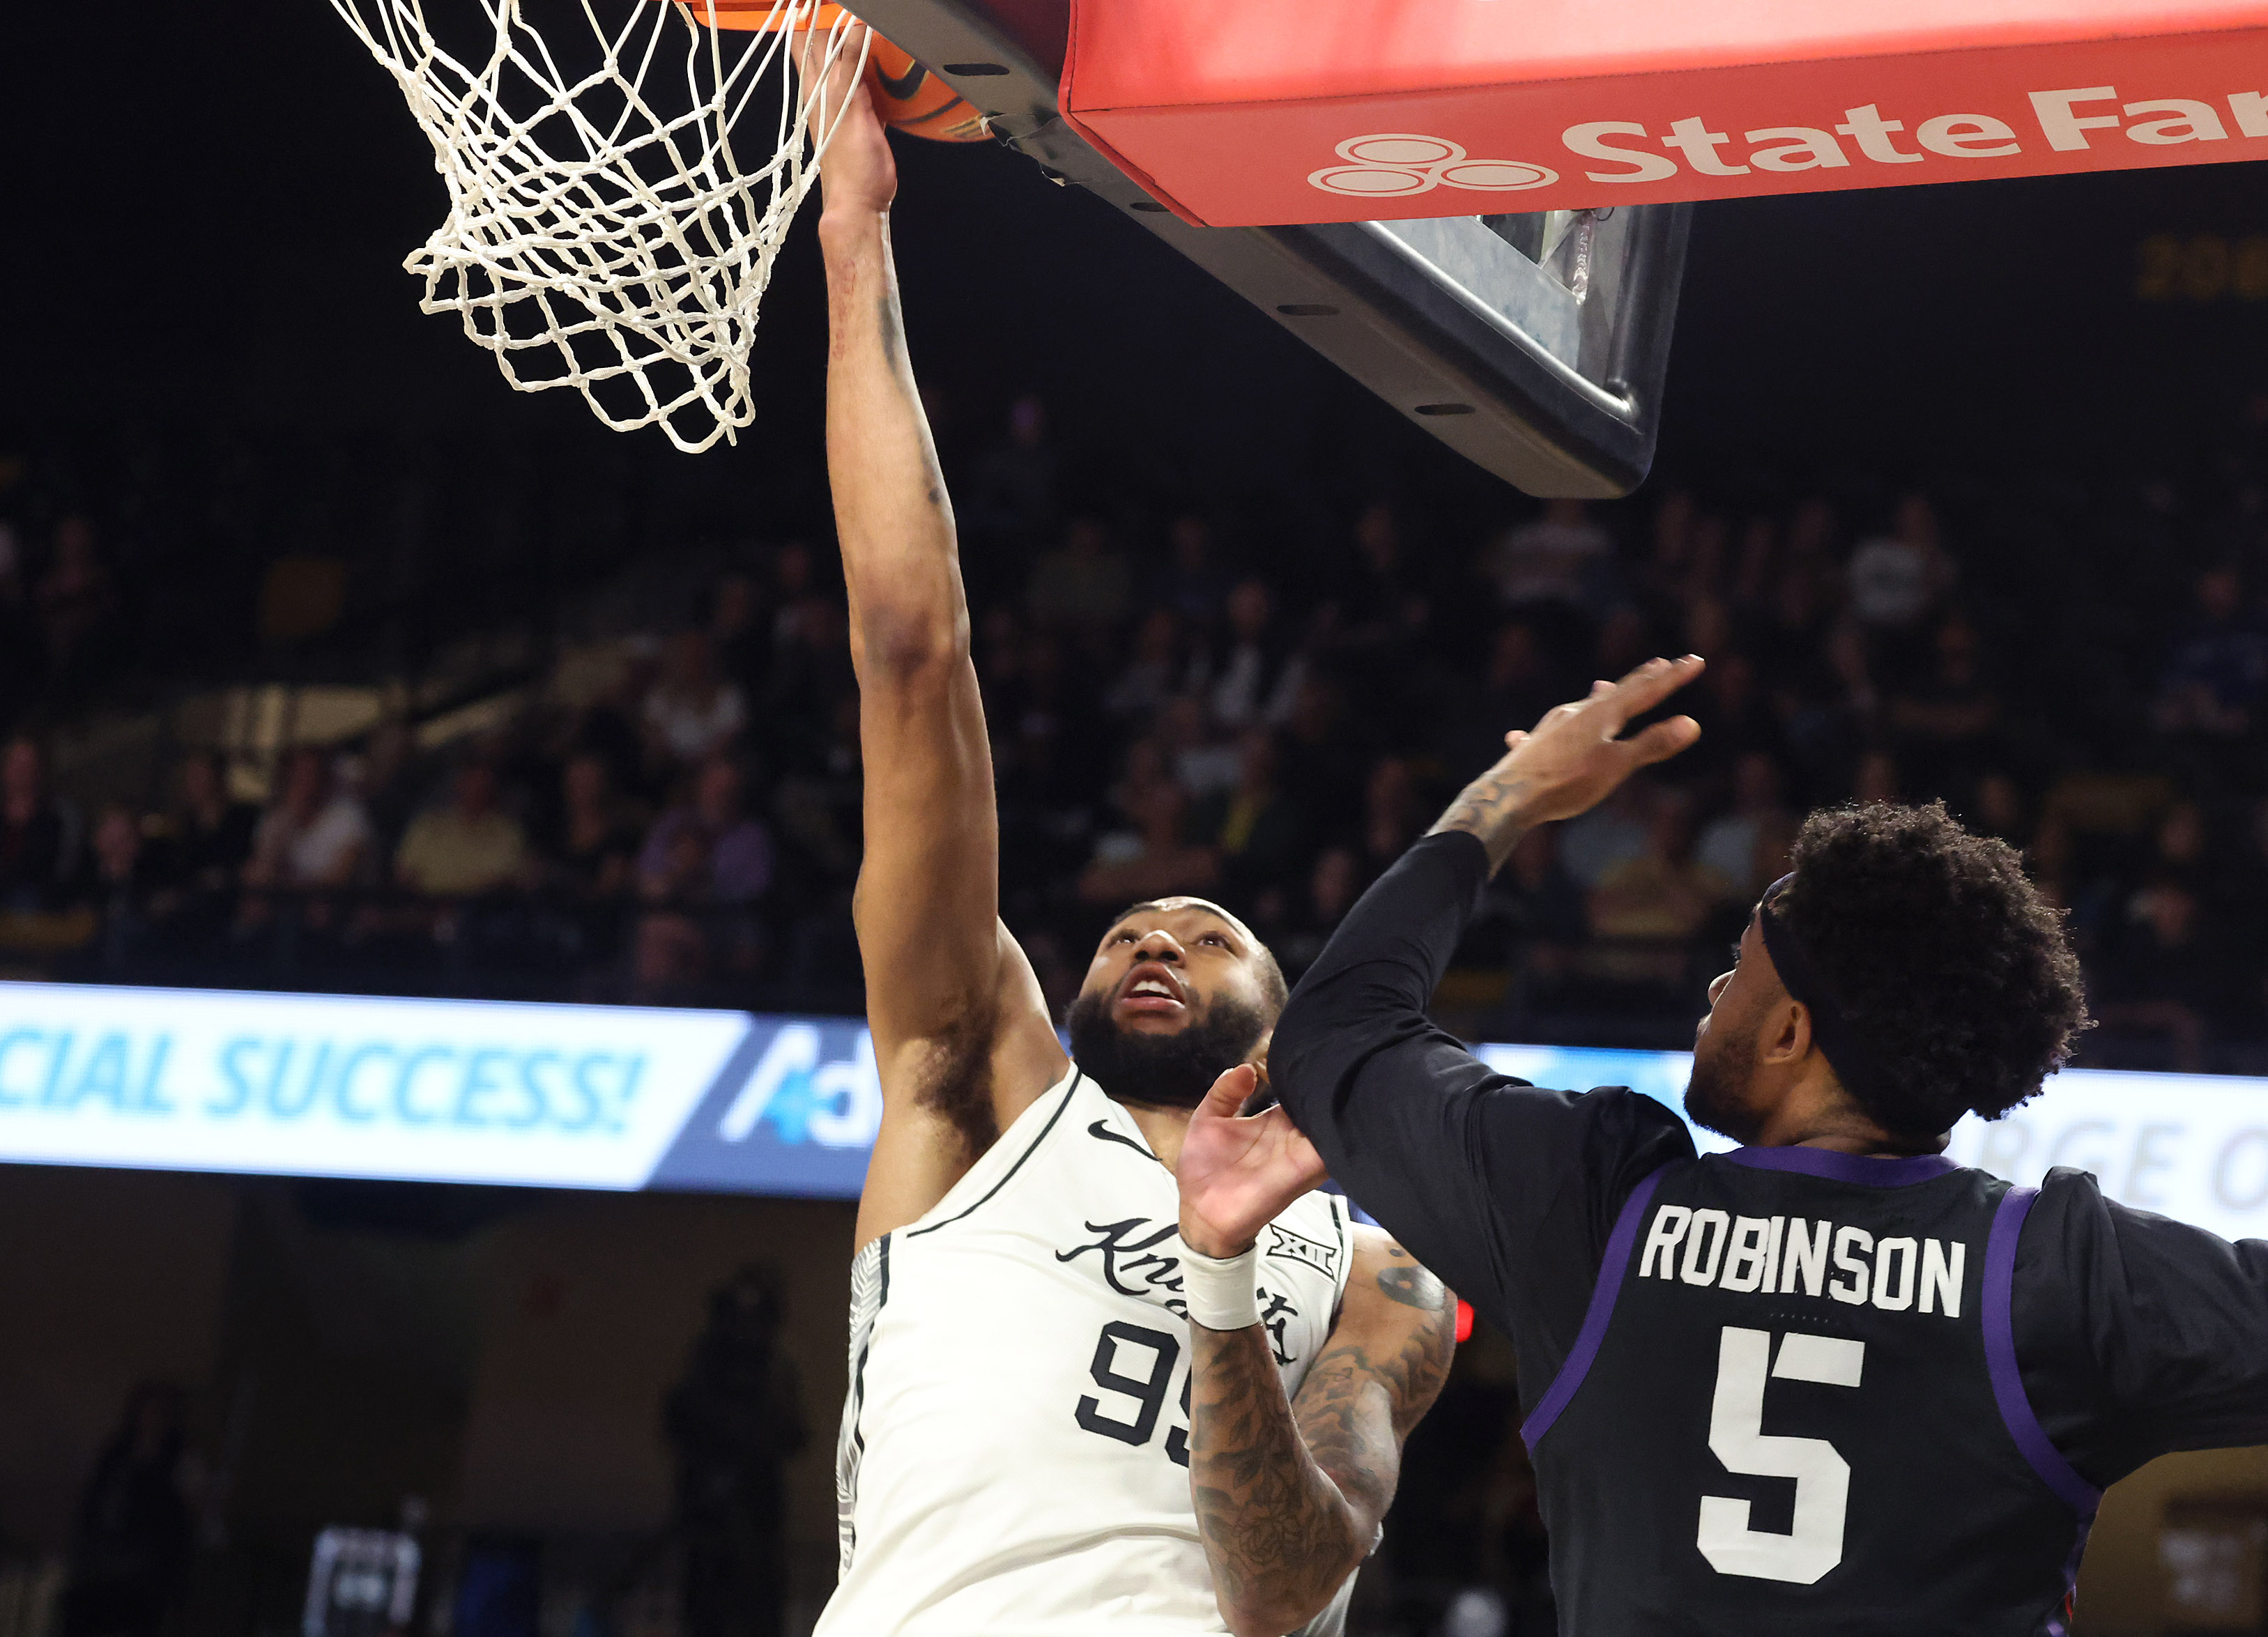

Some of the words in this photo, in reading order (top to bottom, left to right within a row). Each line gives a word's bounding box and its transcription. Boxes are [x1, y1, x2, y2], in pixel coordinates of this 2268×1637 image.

[0, 1028, 177, 1114] CIAL
[202, 1035, 648, 1136] SUCCESS!
[1638, 1204, 1967, 1319] ROBINSON
[1696, 1325, 1866, 1586] 5
